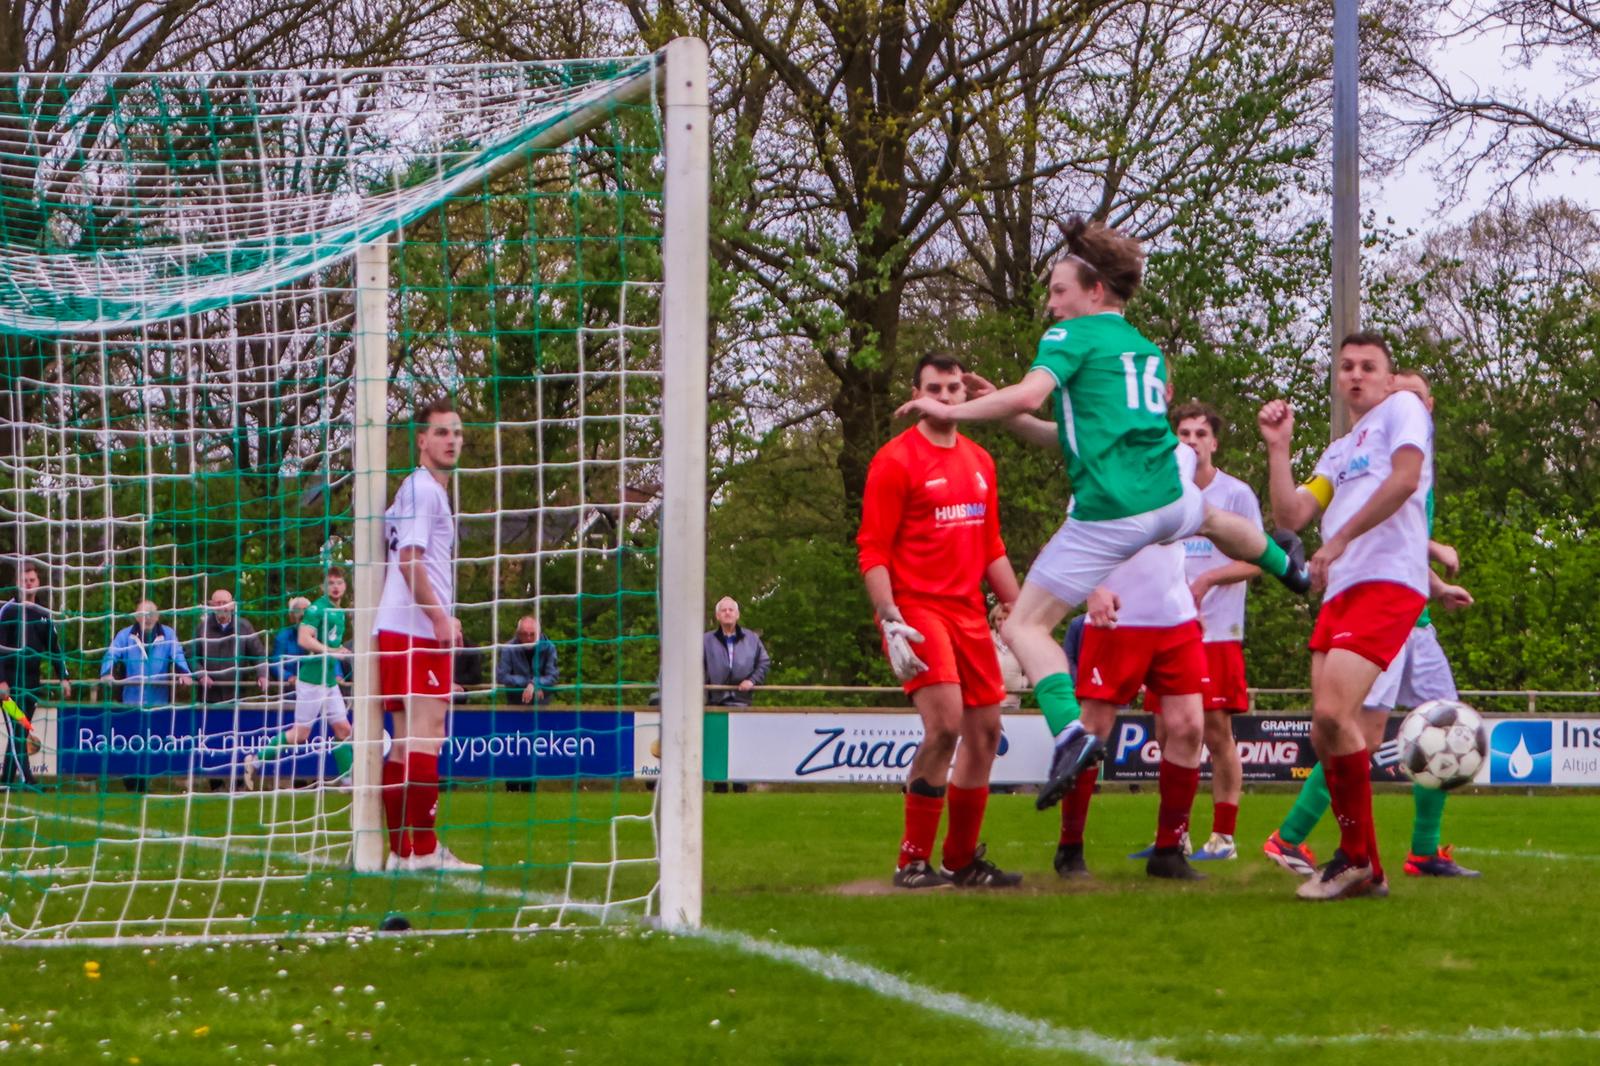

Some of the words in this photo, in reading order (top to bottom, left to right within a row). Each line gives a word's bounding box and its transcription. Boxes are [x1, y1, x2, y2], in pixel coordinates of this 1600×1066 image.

[1120, 351, 1167, 415] 16
[79, 727, 216, 758] Rabobank,
[795, 727, 921, 776] Zwaa
[1562, 758, 1598, 774] Altijd
